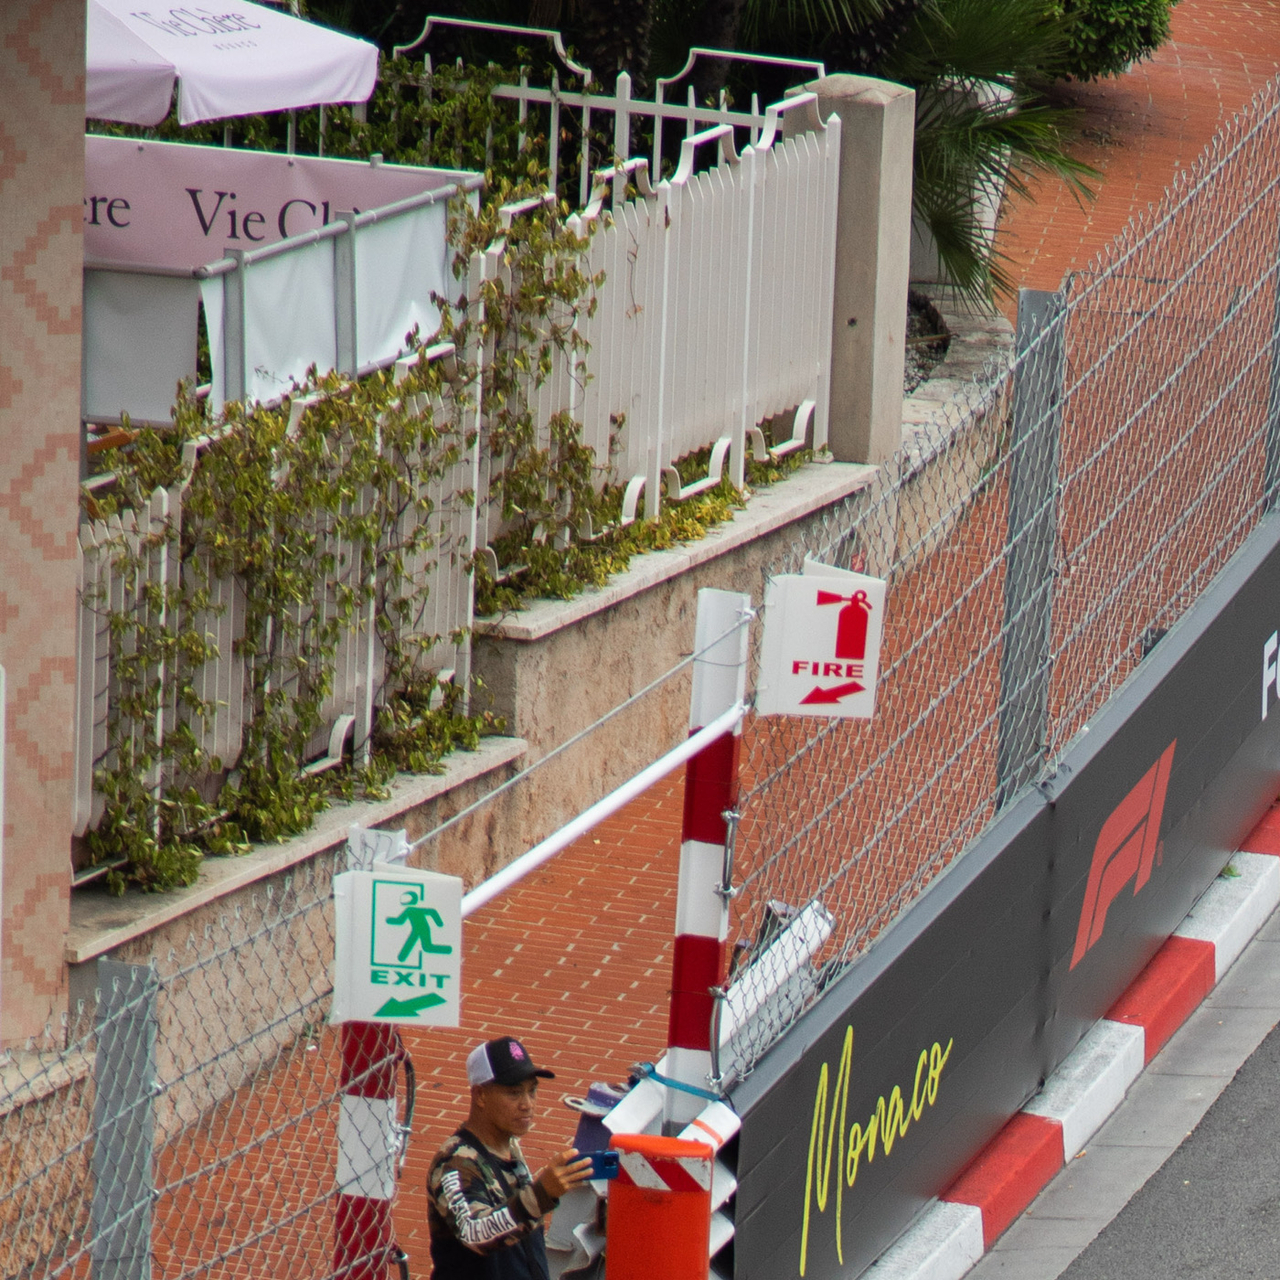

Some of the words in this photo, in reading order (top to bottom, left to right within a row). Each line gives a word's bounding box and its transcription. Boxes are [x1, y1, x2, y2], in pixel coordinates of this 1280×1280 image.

[184, 187, 266, 242] Vie
[792, 660, 864, 679] FIRE
[370, 969, 451, 989] EXIT
[800, 1025, 953, 1277] Monaco
